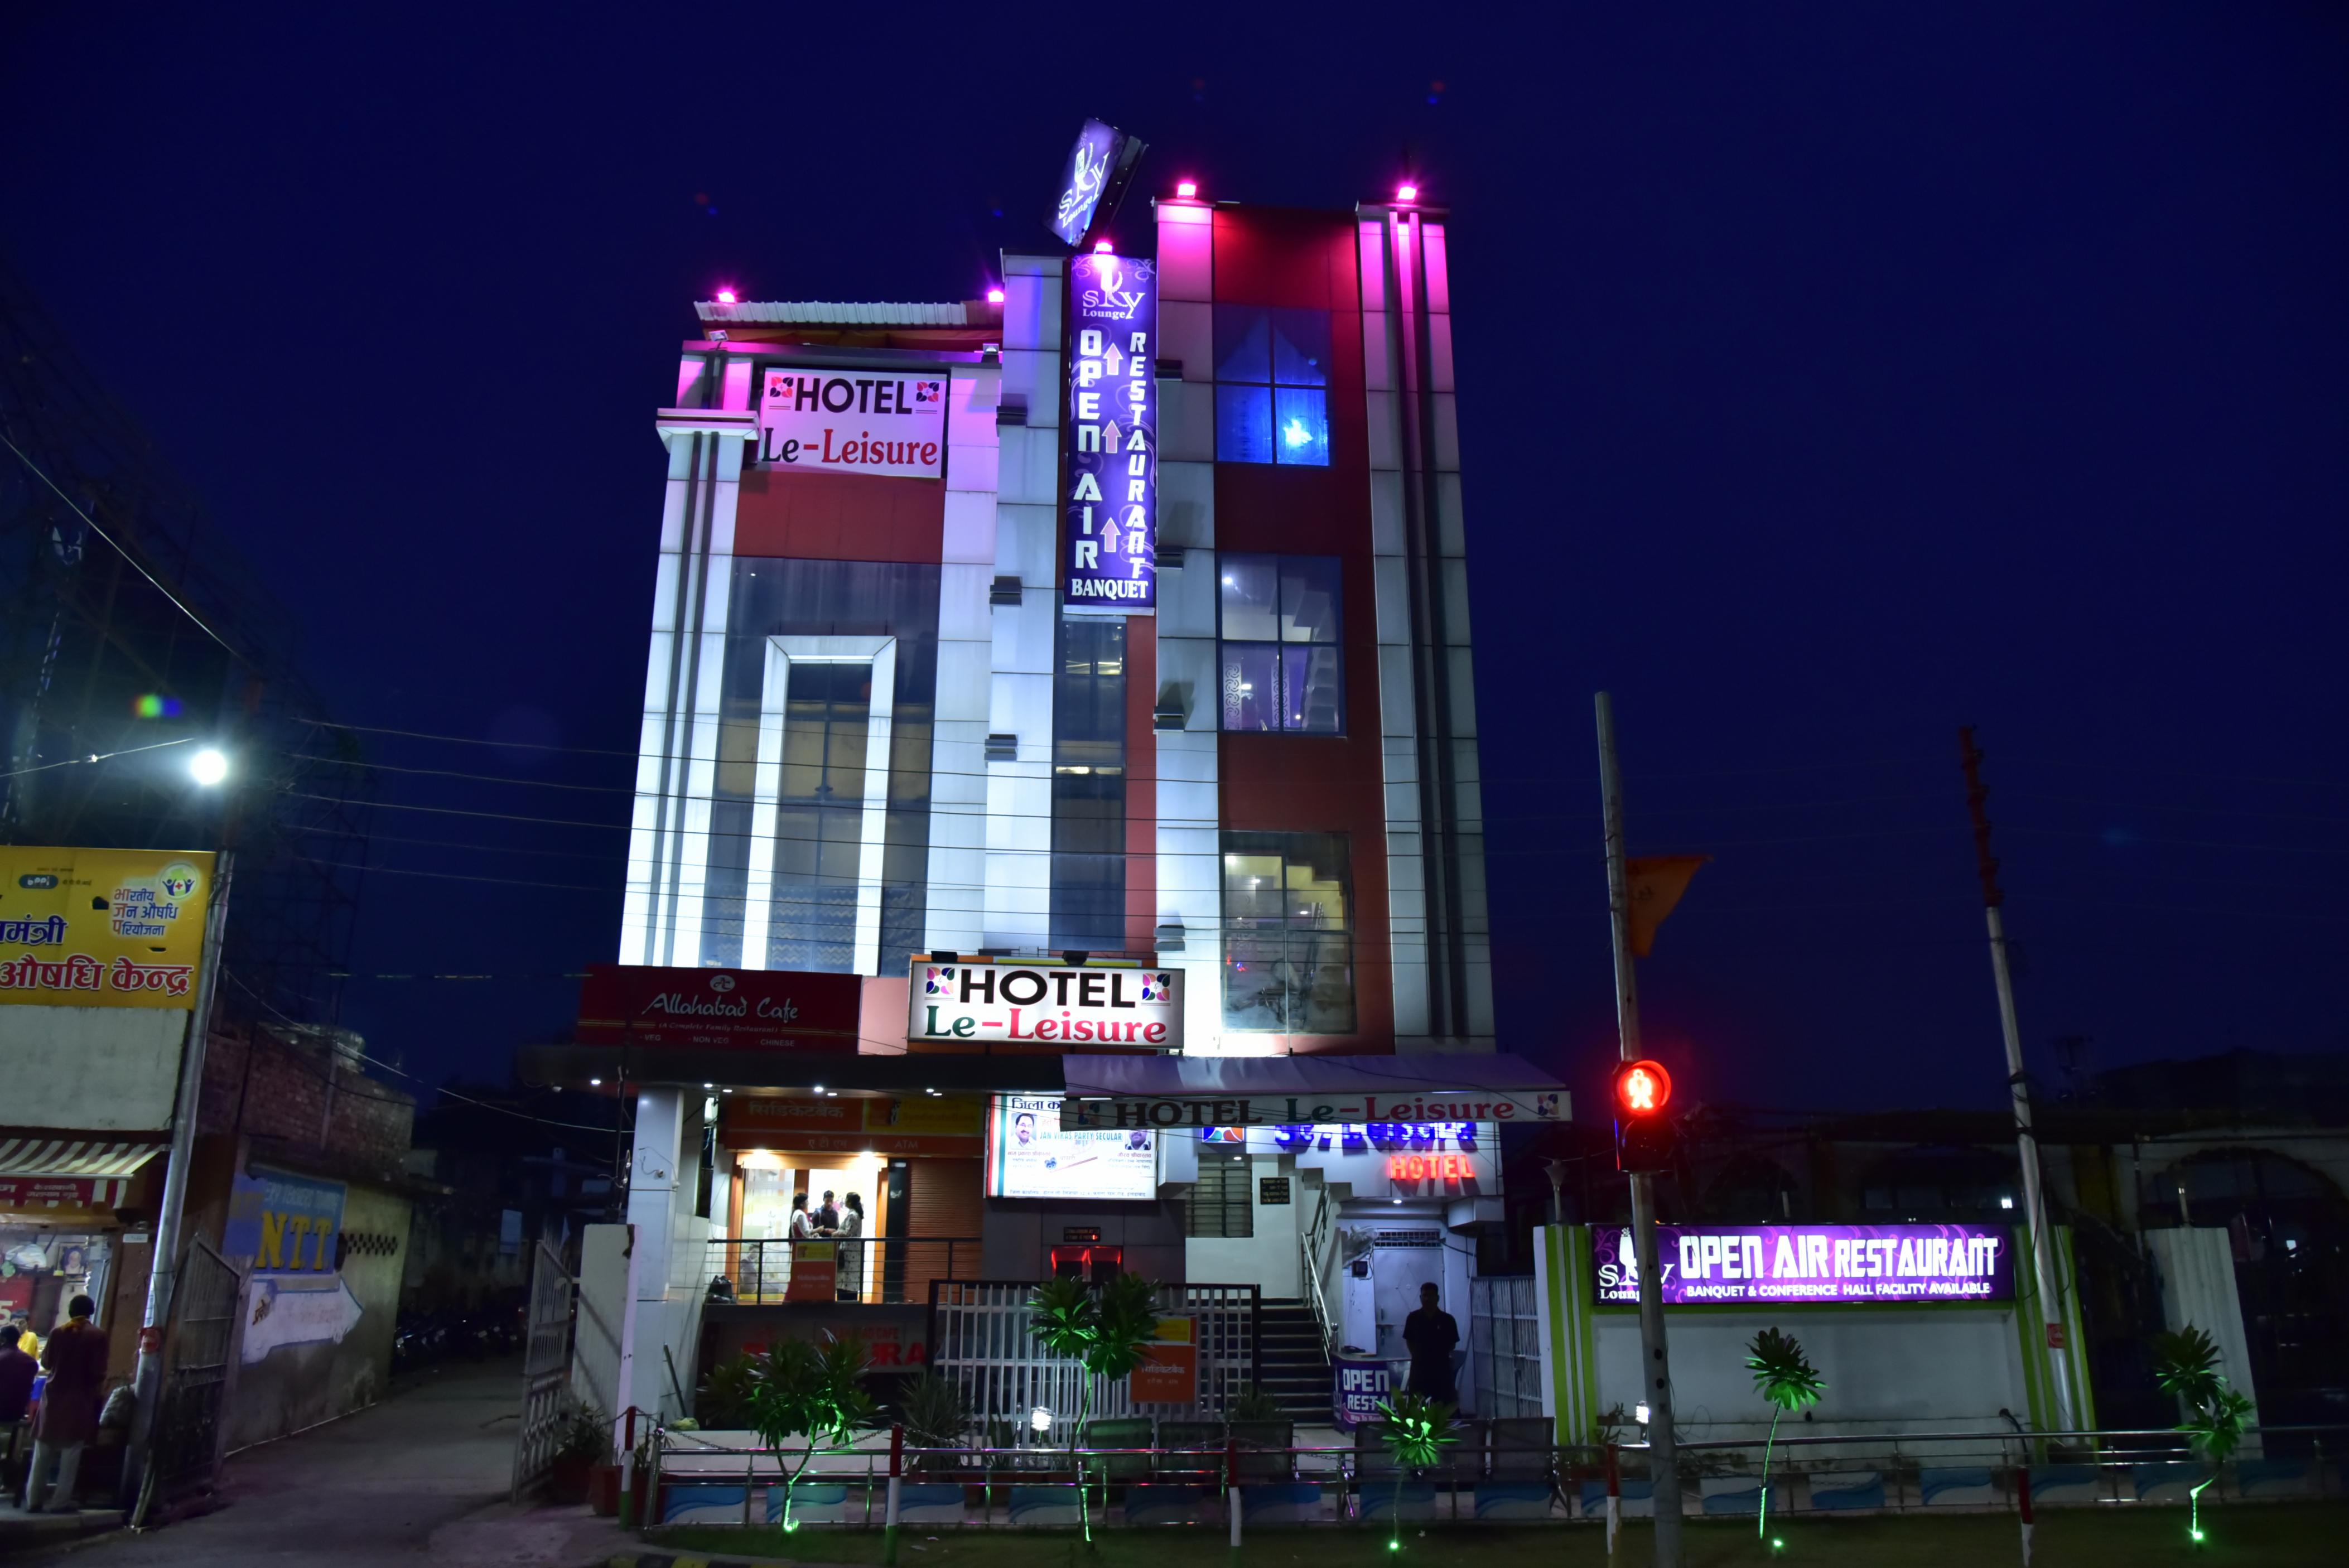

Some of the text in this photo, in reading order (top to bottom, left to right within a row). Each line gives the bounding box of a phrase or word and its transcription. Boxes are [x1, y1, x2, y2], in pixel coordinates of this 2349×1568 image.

[1062, 196, 1093, 229] Lounge
[1082, 308, 1125, 320] Lounge
[795, 377, 912, 415] HOTEL
[1073, 472, 1102, 570] AIR
[1071, 579, 1149, 599] BANQUET
[114, 889, 155, 902] भारतीय
[113, 903, 179, 919] जन औषधि
[113, 920, 165, 937] परियोजना
[112, 957, 194, 996] केन्द्र
[960, 969, 1136, 1008] HOTEL
[641, 993, 798, 1024] Allahabad Cafe
[669, 1022, 703, 1030] Complete
[706, 1024, 730, 1033] Family
[1012, 1097, 1043, 1109] जिला
[1116, 1099, 1262, 1128] HOTEL
[895, 1140, 919, 1149] ATM
[1095, 1132, 1122, 1141] SECULAR
[1390, 1155, 1475, 1179] HOTEL
[255, 1210, 332, 1270] NTT
[1679, 1234, 1998, 1279] OPEN AIR RESTAURANT
[1686, 1282, 1990, 1298] BANQUET & CONFERENCE HALL FACILITY AVAILABLE
[1343, 1368, 1390, 1392] OPEN
